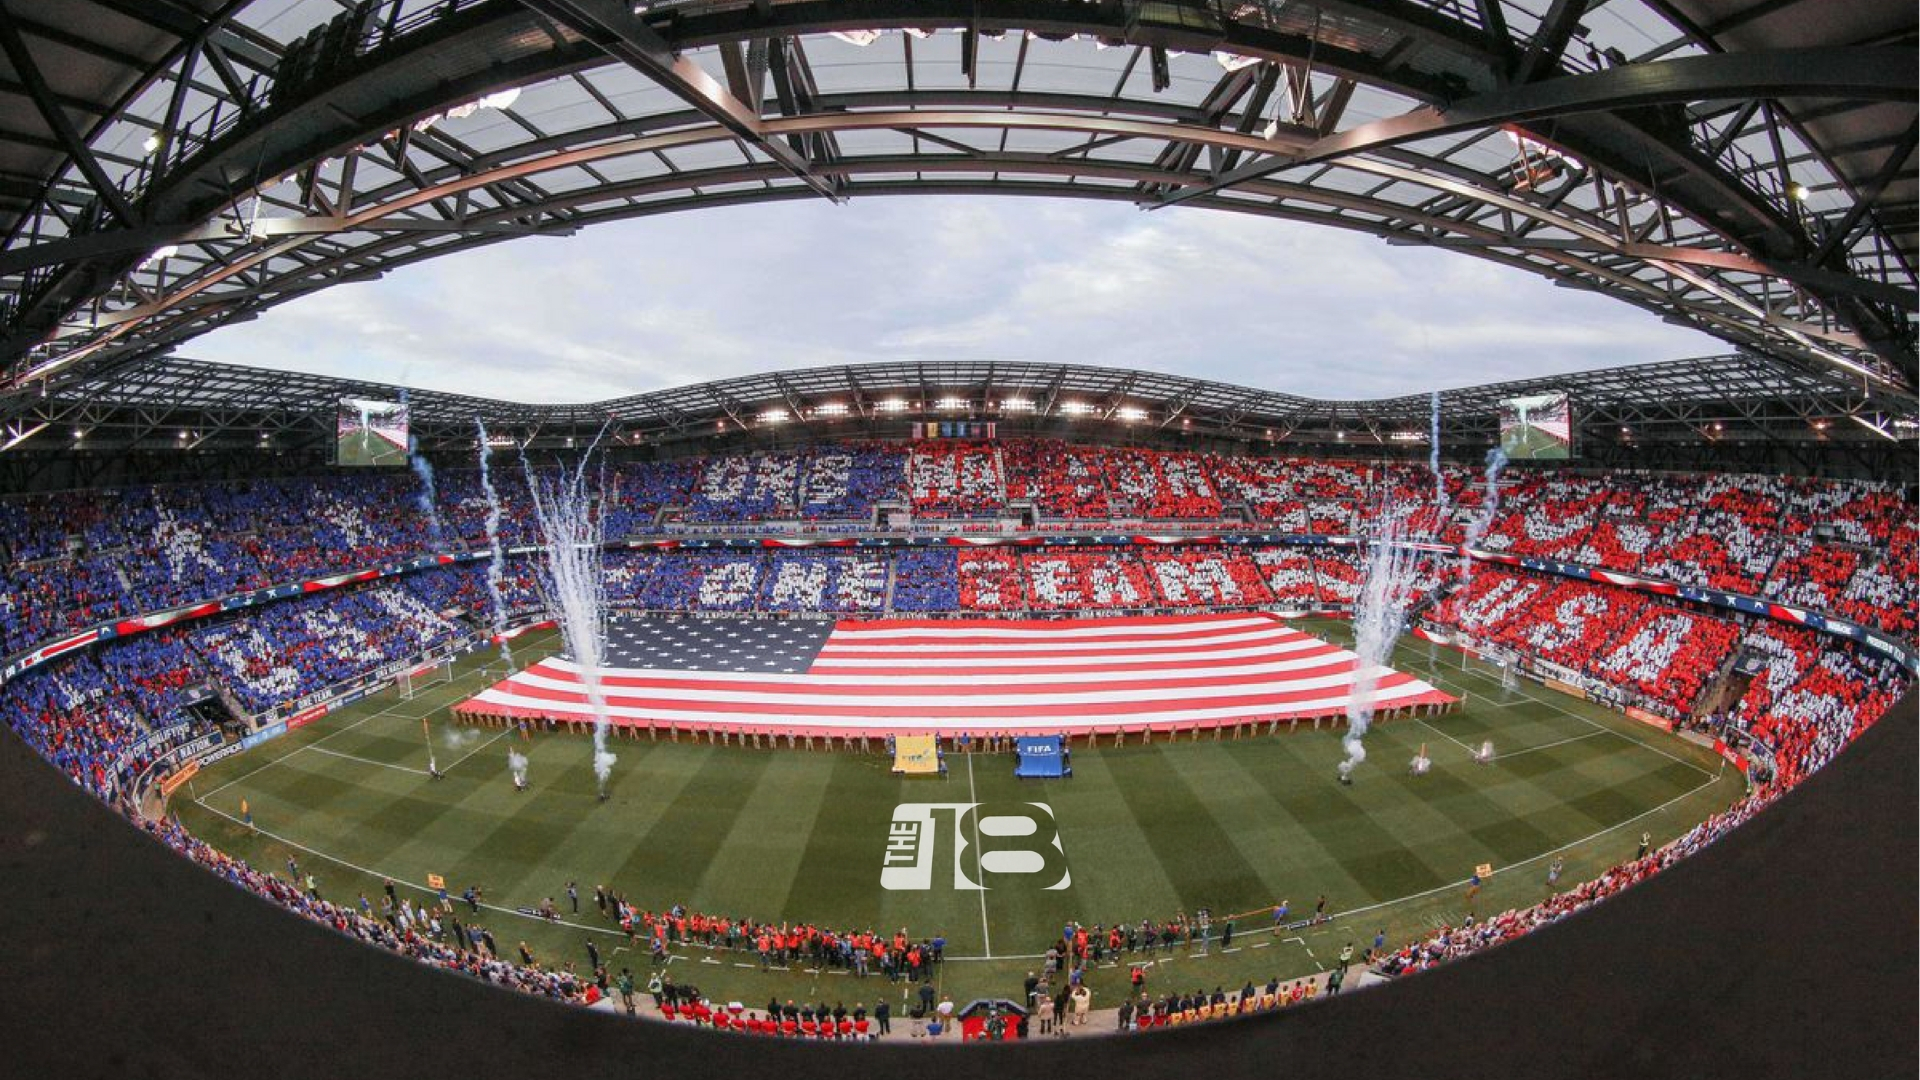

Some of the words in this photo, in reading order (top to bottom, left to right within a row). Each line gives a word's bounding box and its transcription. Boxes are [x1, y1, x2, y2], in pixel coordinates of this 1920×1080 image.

[699, 561, 887, 607] ONE
[961, 559, 1242, 606] TEAM
[1459, 578, 1695, 681] USA
[1027, 745, 1052, 753] FIFA
